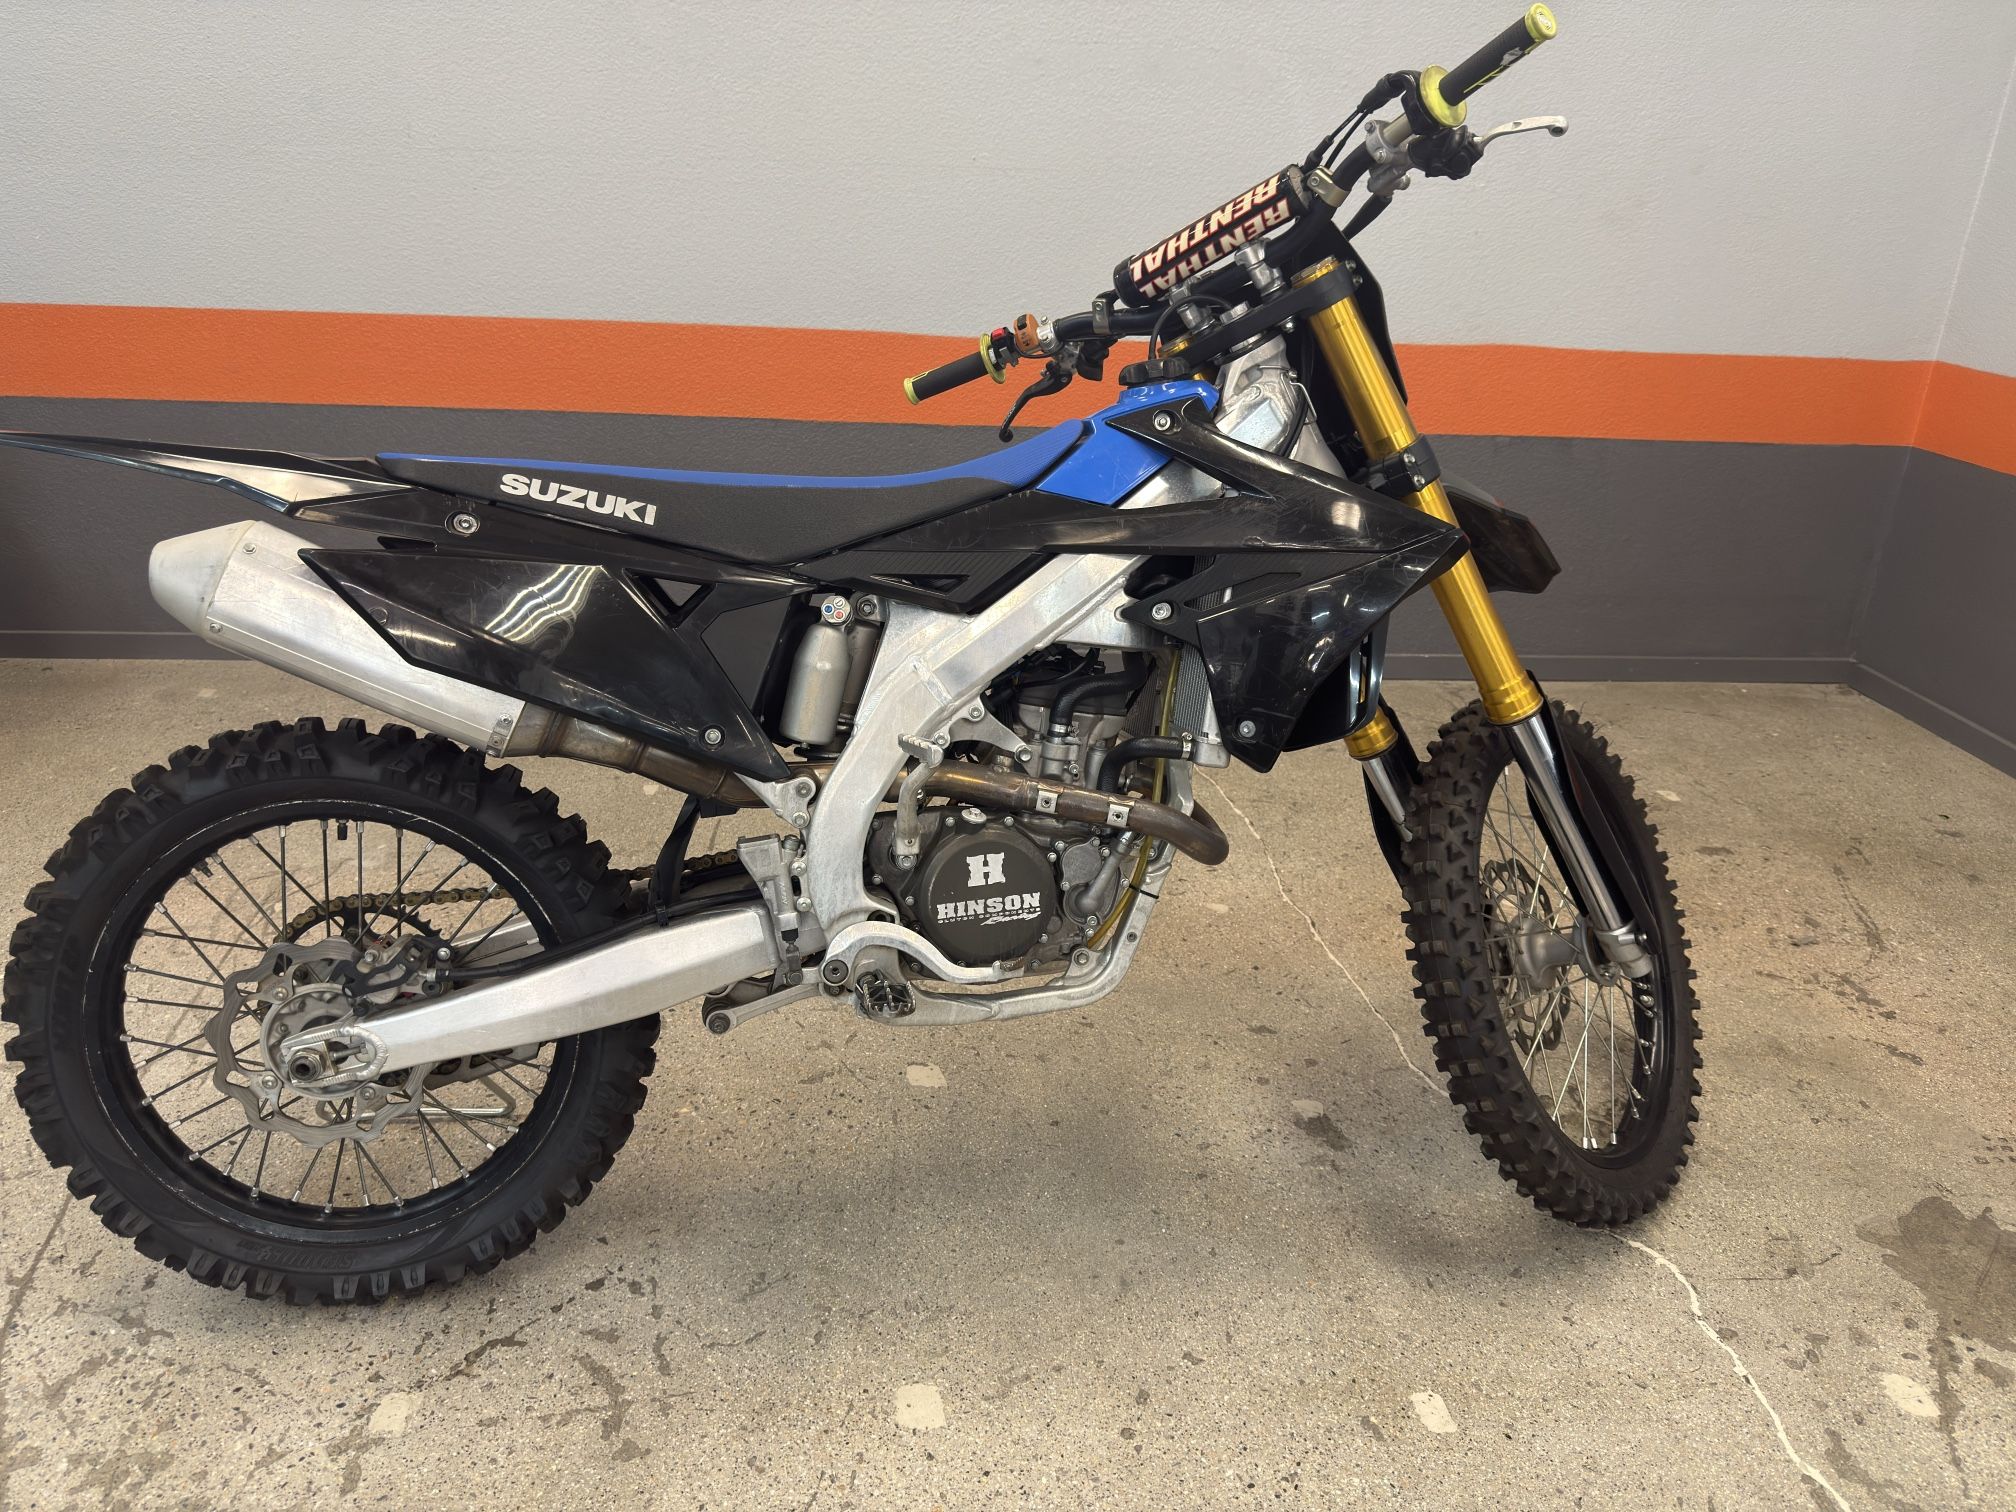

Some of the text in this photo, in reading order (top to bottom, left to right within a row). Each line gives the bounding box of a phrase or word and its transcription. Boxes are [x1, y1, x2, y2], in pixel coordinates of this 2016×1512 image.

[1129, 174, 1281, 283] RENTHAL
[1138, 198, 1291, 299] RENTHAL
[500, 473, 657, 526] SUZUKI
[966, 852, 1006, 887] H
[937, 892, 1041, 919] HINSON
